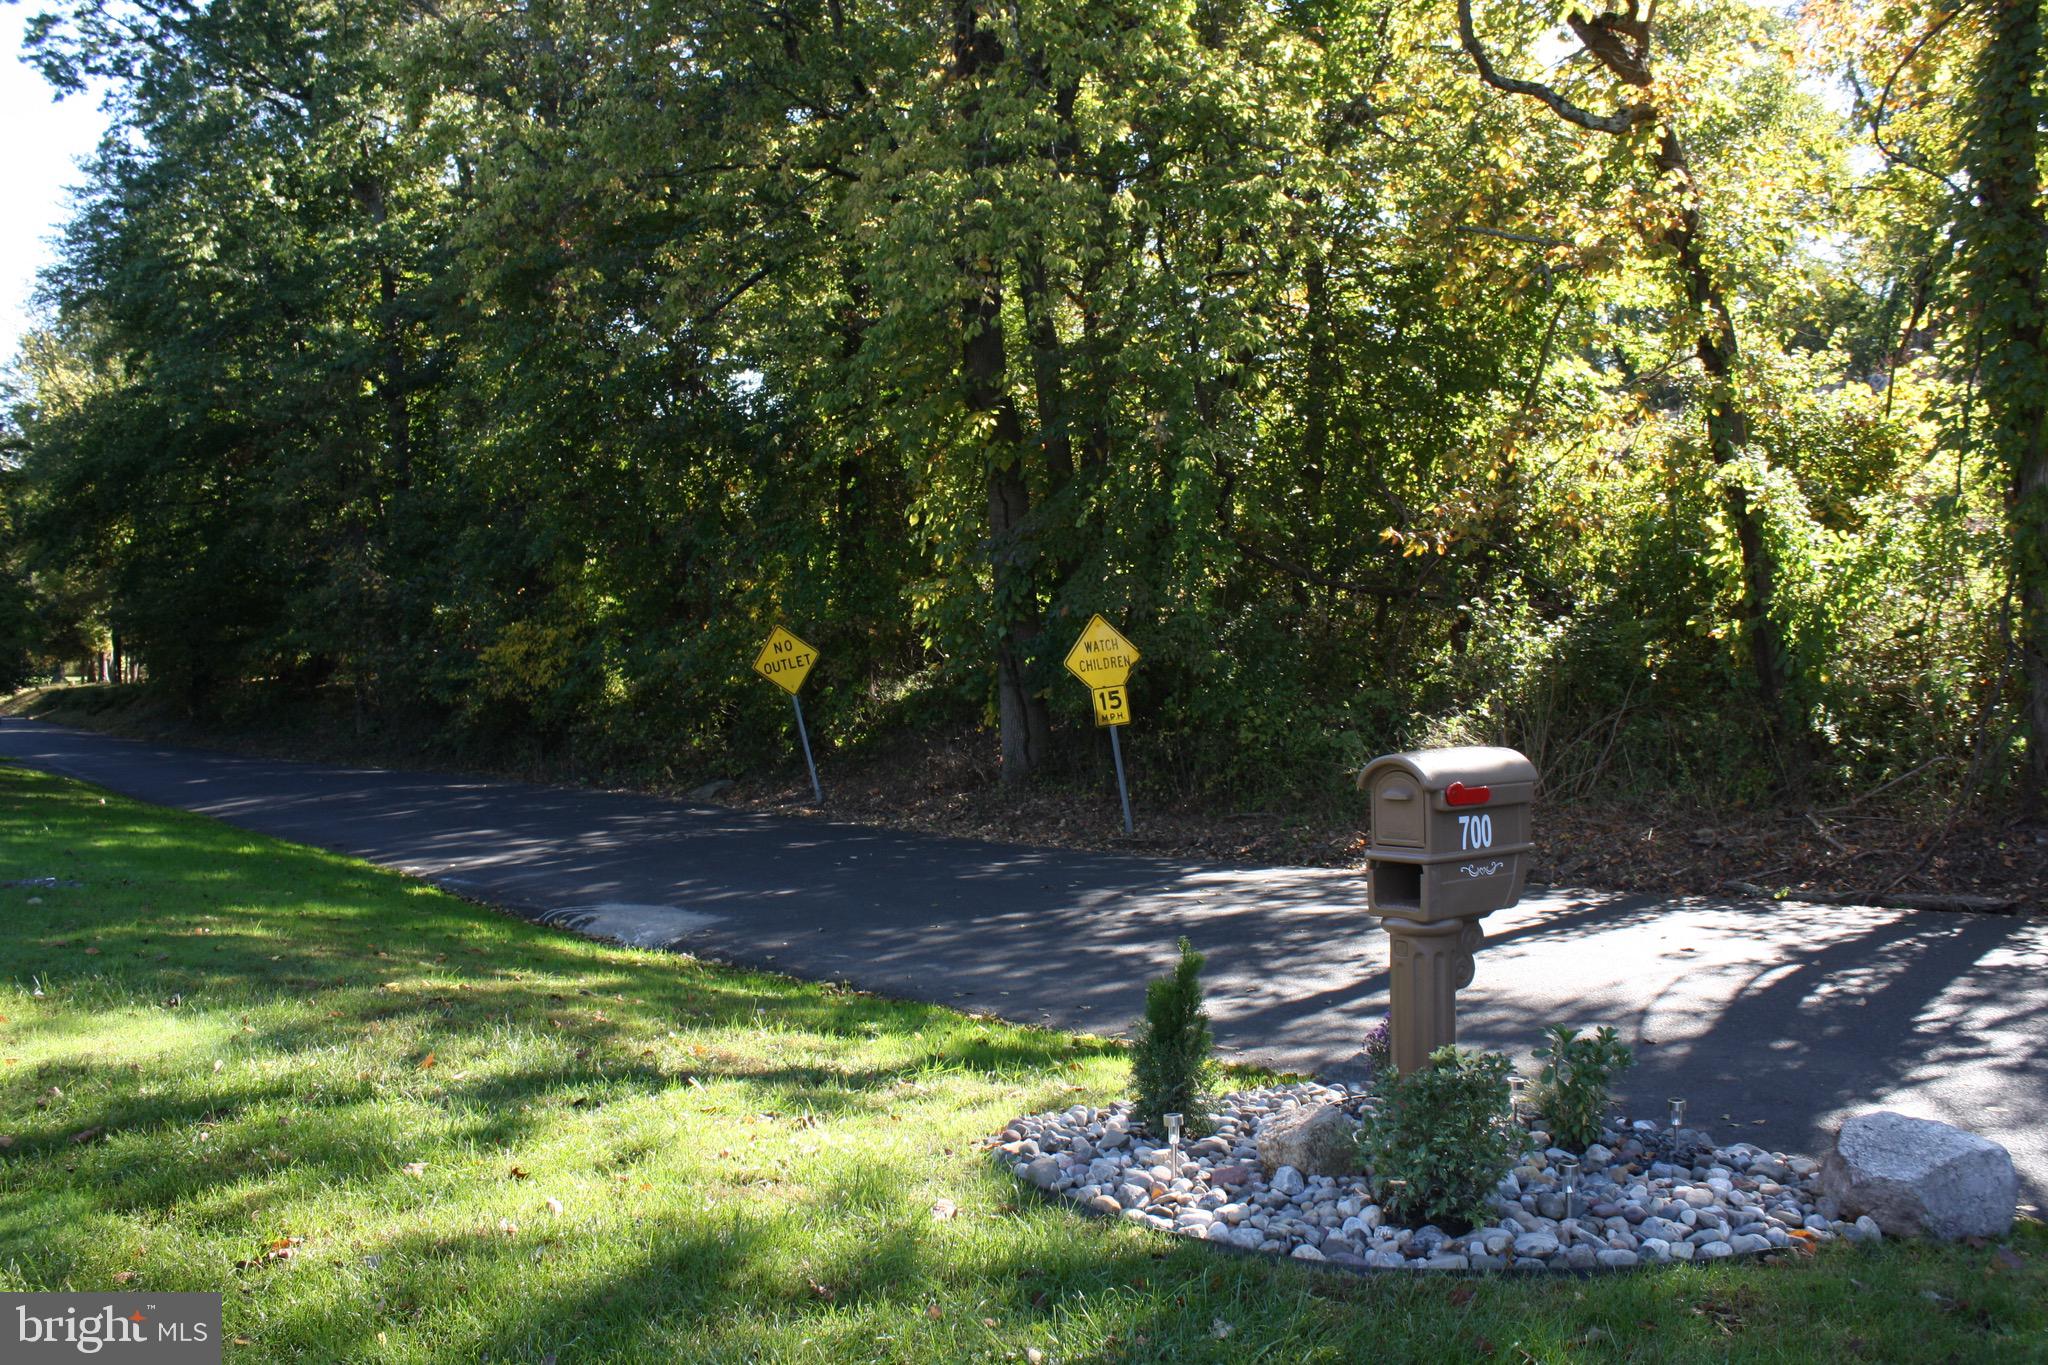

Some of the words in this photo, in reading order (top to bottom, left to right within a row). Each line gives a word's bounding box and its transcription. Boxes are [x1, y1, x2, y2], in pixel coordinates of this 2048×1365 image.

[774, 640, 792, 654] NO
[1084, 639, 1119, 653] WATCH
[764, 654, 810, 674] OUTLET
[1080, 655, 1131, 672] CHILDREN
[1099, 690, 1122, 711] 15
[1458, 814, 1492, 850] 700
